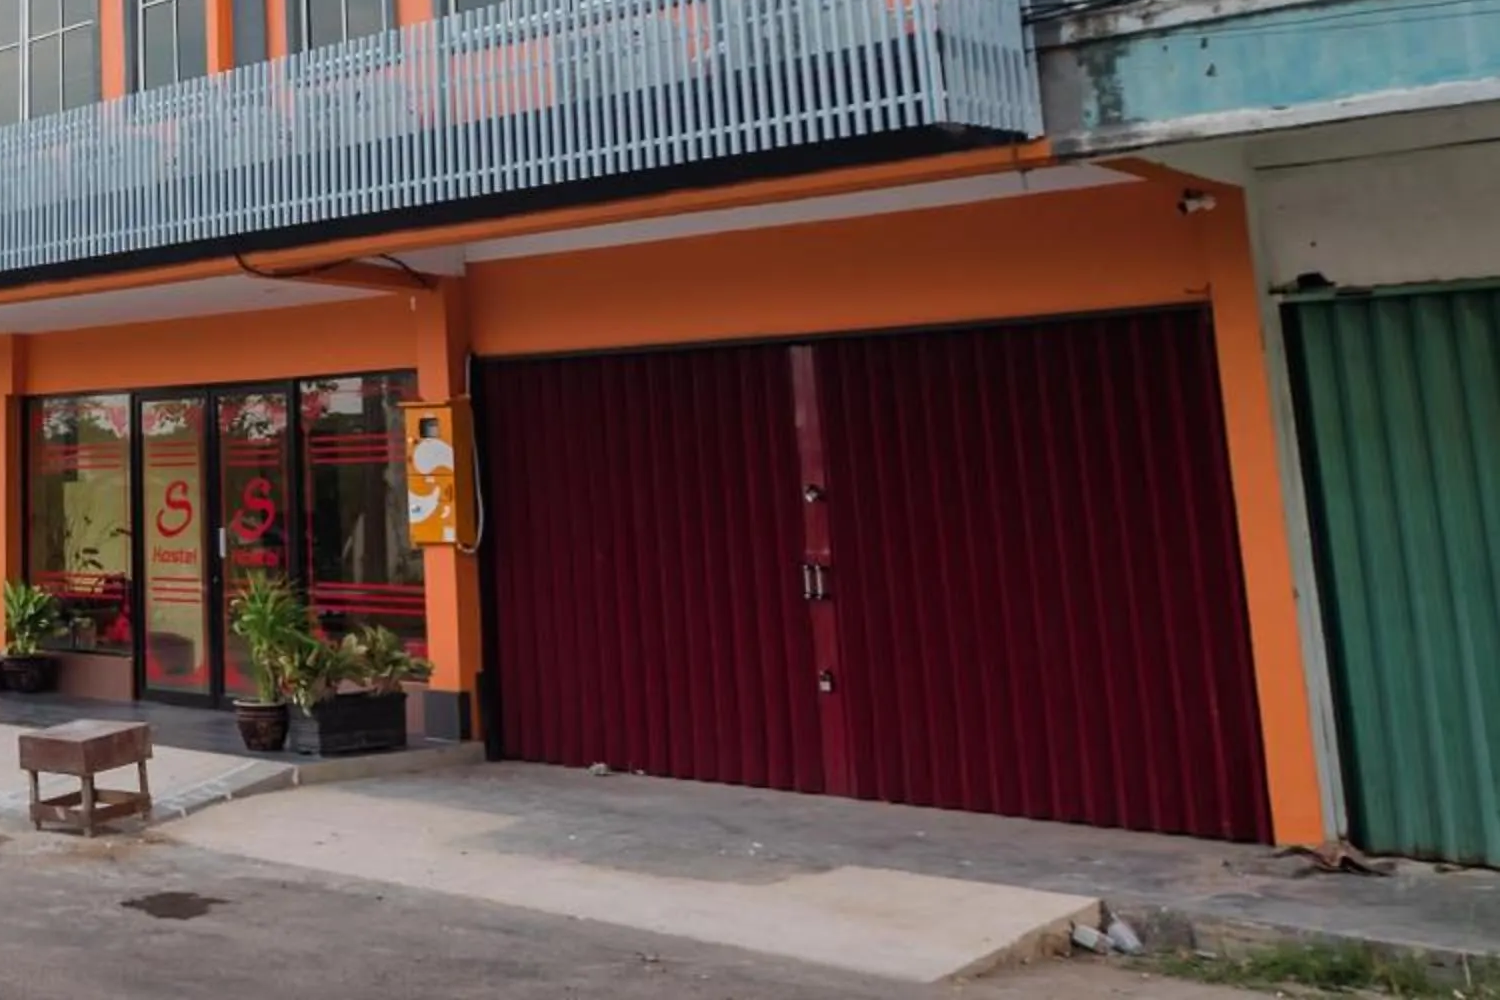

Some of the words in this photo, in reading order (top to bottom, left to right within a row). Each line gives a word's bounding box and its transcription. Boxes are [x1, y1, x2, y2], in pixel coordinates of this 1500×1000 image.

[156, 480, 192, 537] S
[230, 477, 276, 542] S
[152, 546, 197, 564] Hostel
